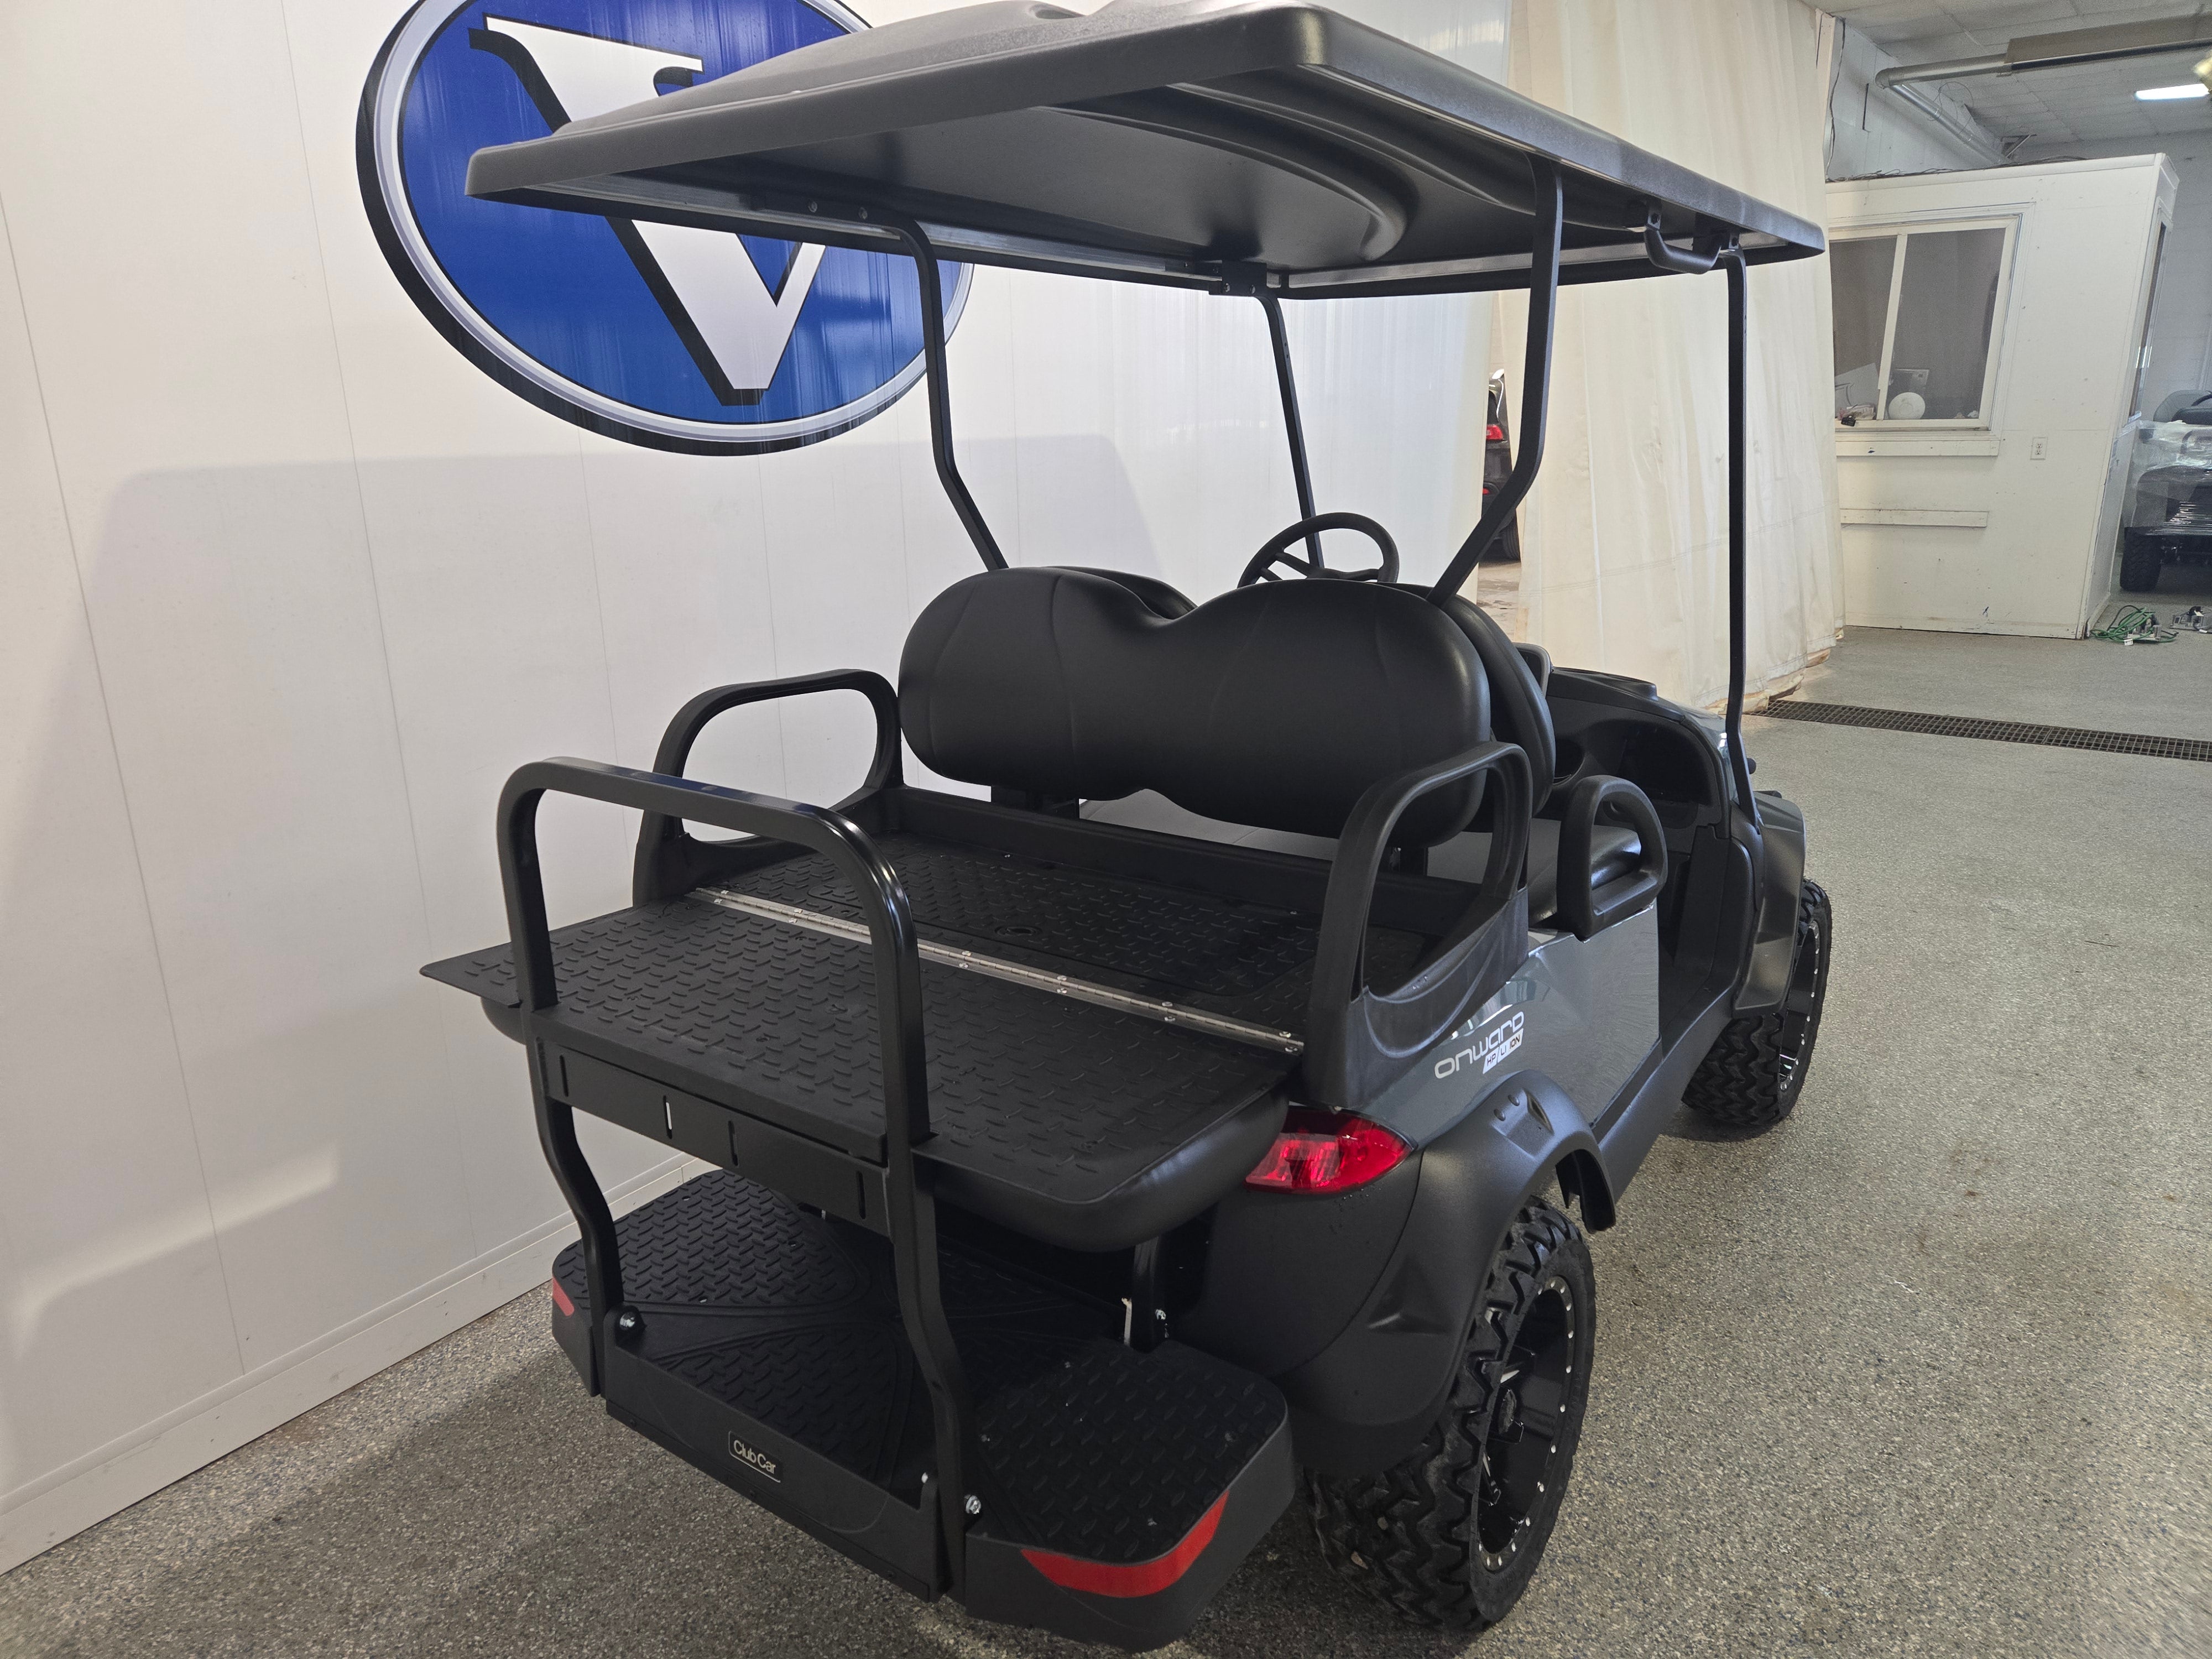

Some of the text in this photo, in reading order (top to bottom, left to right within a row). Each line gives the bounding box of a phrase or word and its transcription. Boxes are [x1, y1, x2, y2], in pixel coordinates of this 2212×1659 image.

[1487, 1053, 1496, 1066] HP
[1510, 1034, 1520, 1049] ION
[733, 1439, 776, 1474] Club Car
